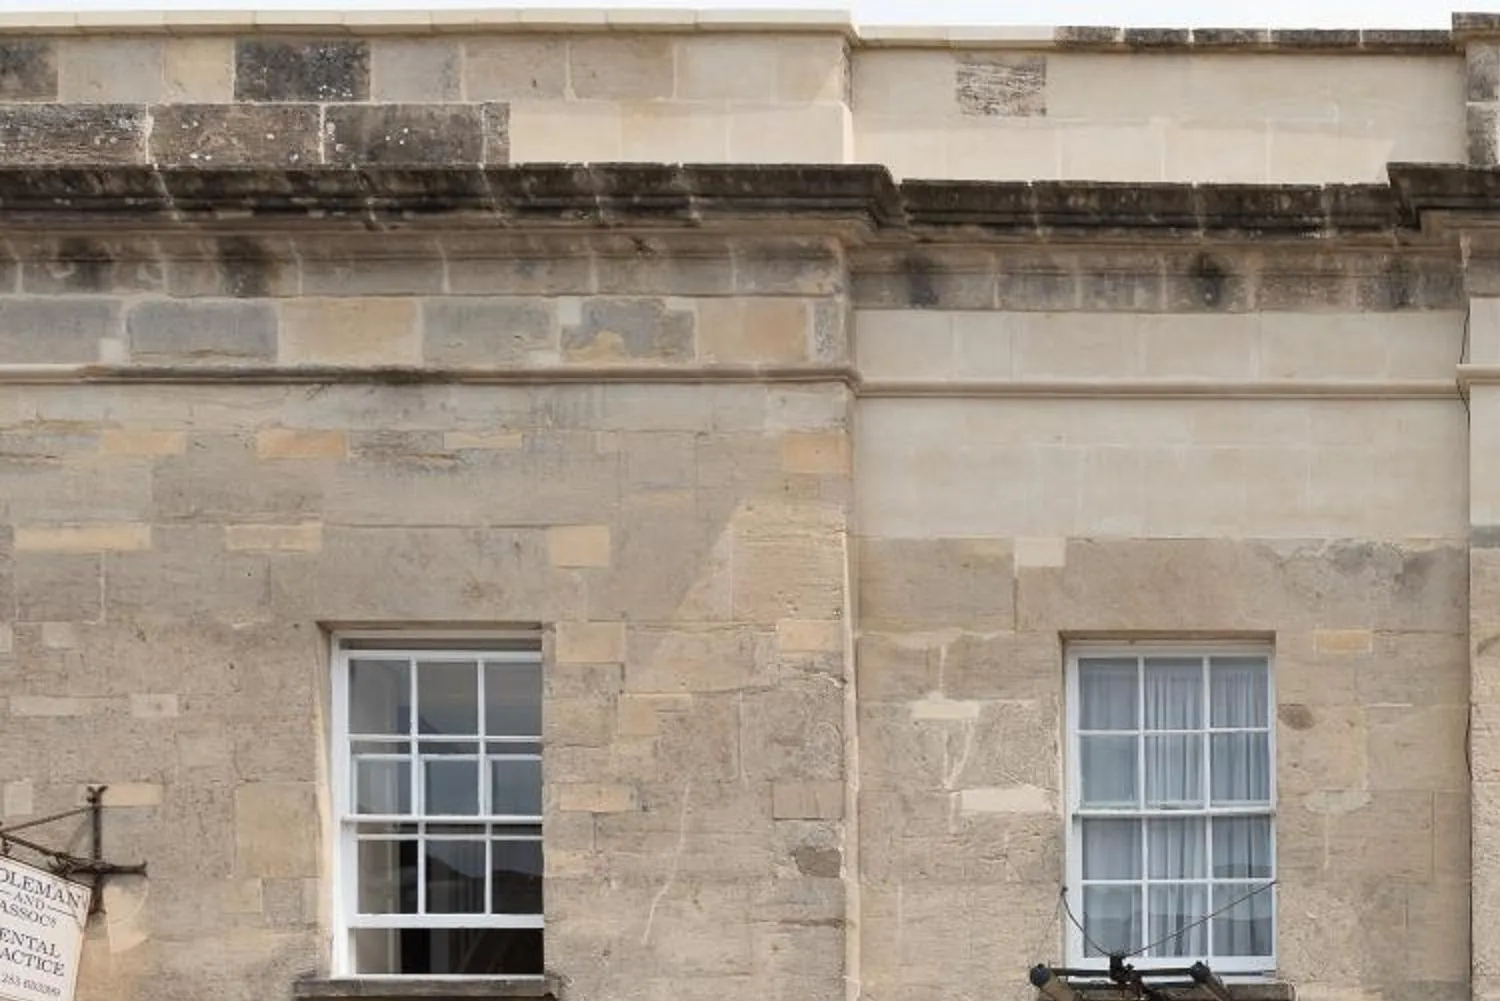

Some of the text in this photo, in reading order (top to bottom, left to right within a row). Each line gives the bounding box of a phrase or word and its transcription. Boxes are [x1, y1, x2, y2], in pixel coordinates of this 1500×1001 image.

[14, 891, 45, 910] AND
[0, 927, 61, 958] ENTAL
[0, 947, 65, 977] ACTICE
